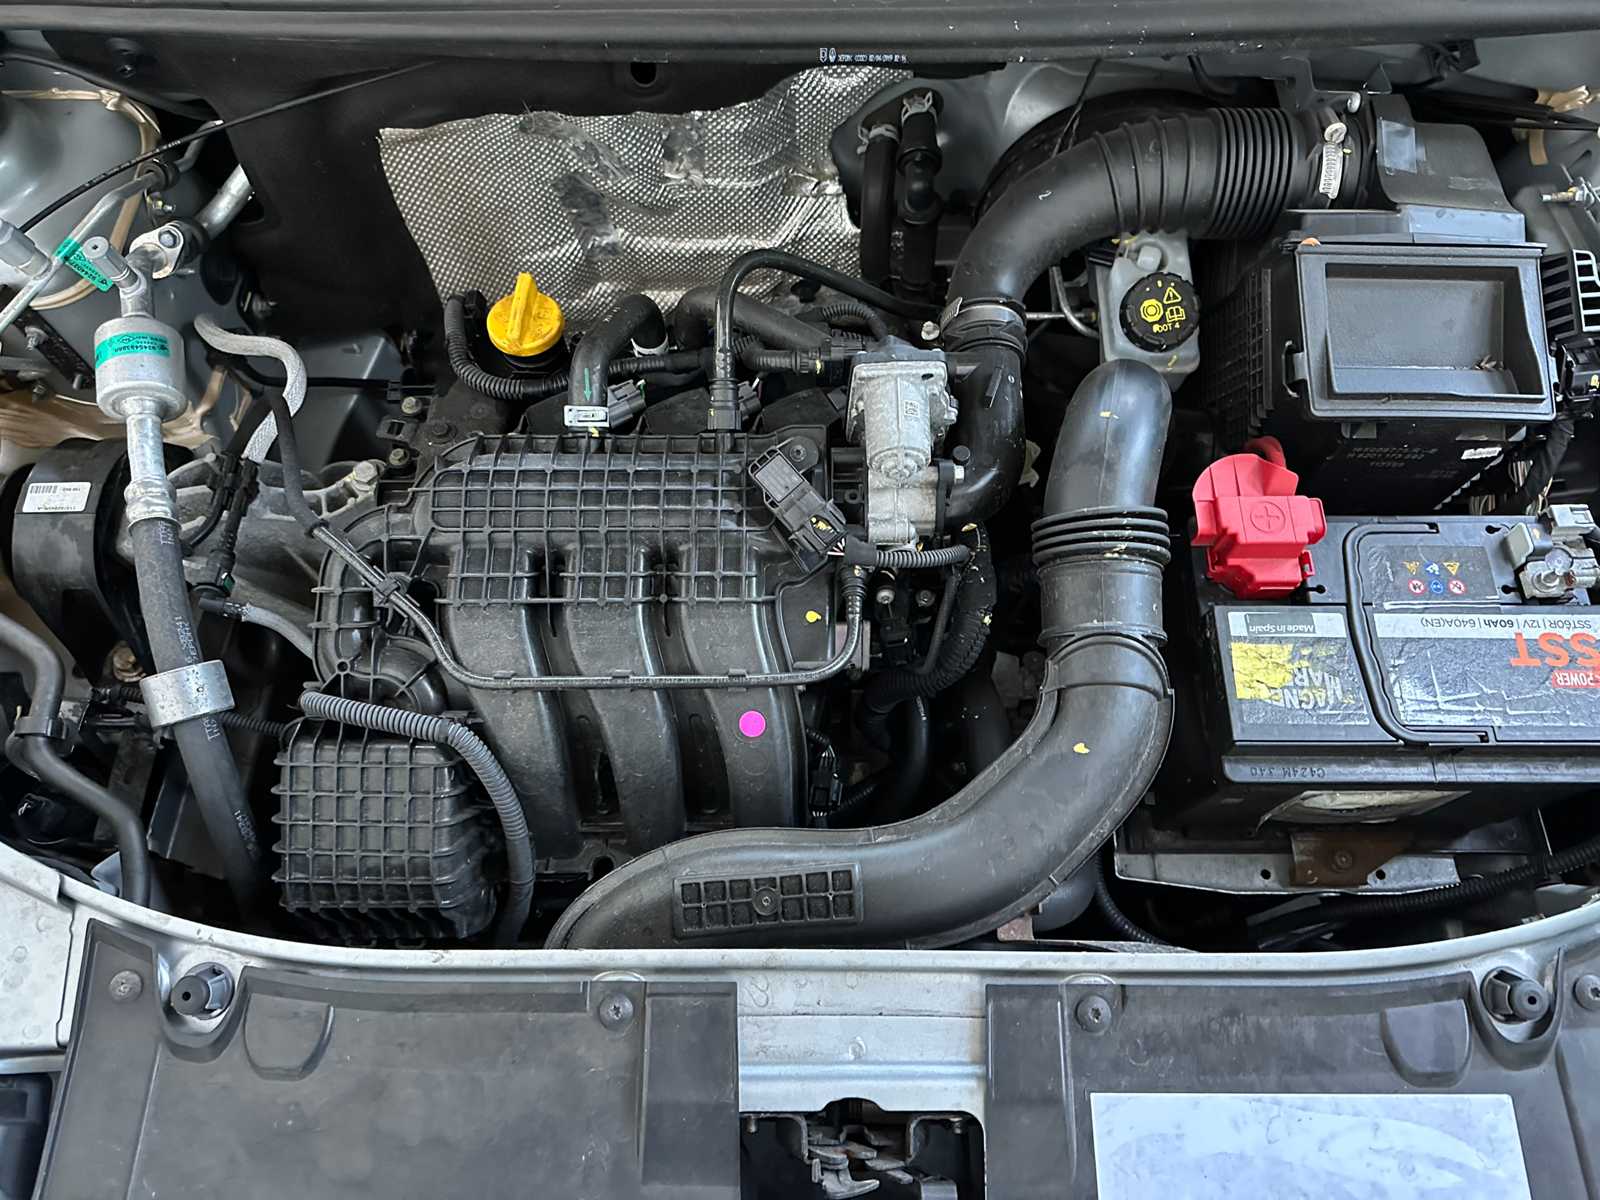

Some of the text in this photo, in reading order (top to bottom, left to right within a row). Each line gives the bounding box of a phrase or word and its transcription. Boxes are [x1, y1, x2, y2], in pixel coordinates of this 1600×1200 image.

[1248, 623, 1276, 634] Spain
[1287, 623, 1315, 633] Made
[1420, 617, 1592, 630] SST60R 12V 60Ah 640A(EN)
[1510, 632, 1600, 667] SST
[1555, 672, 1596, 686] POWER
